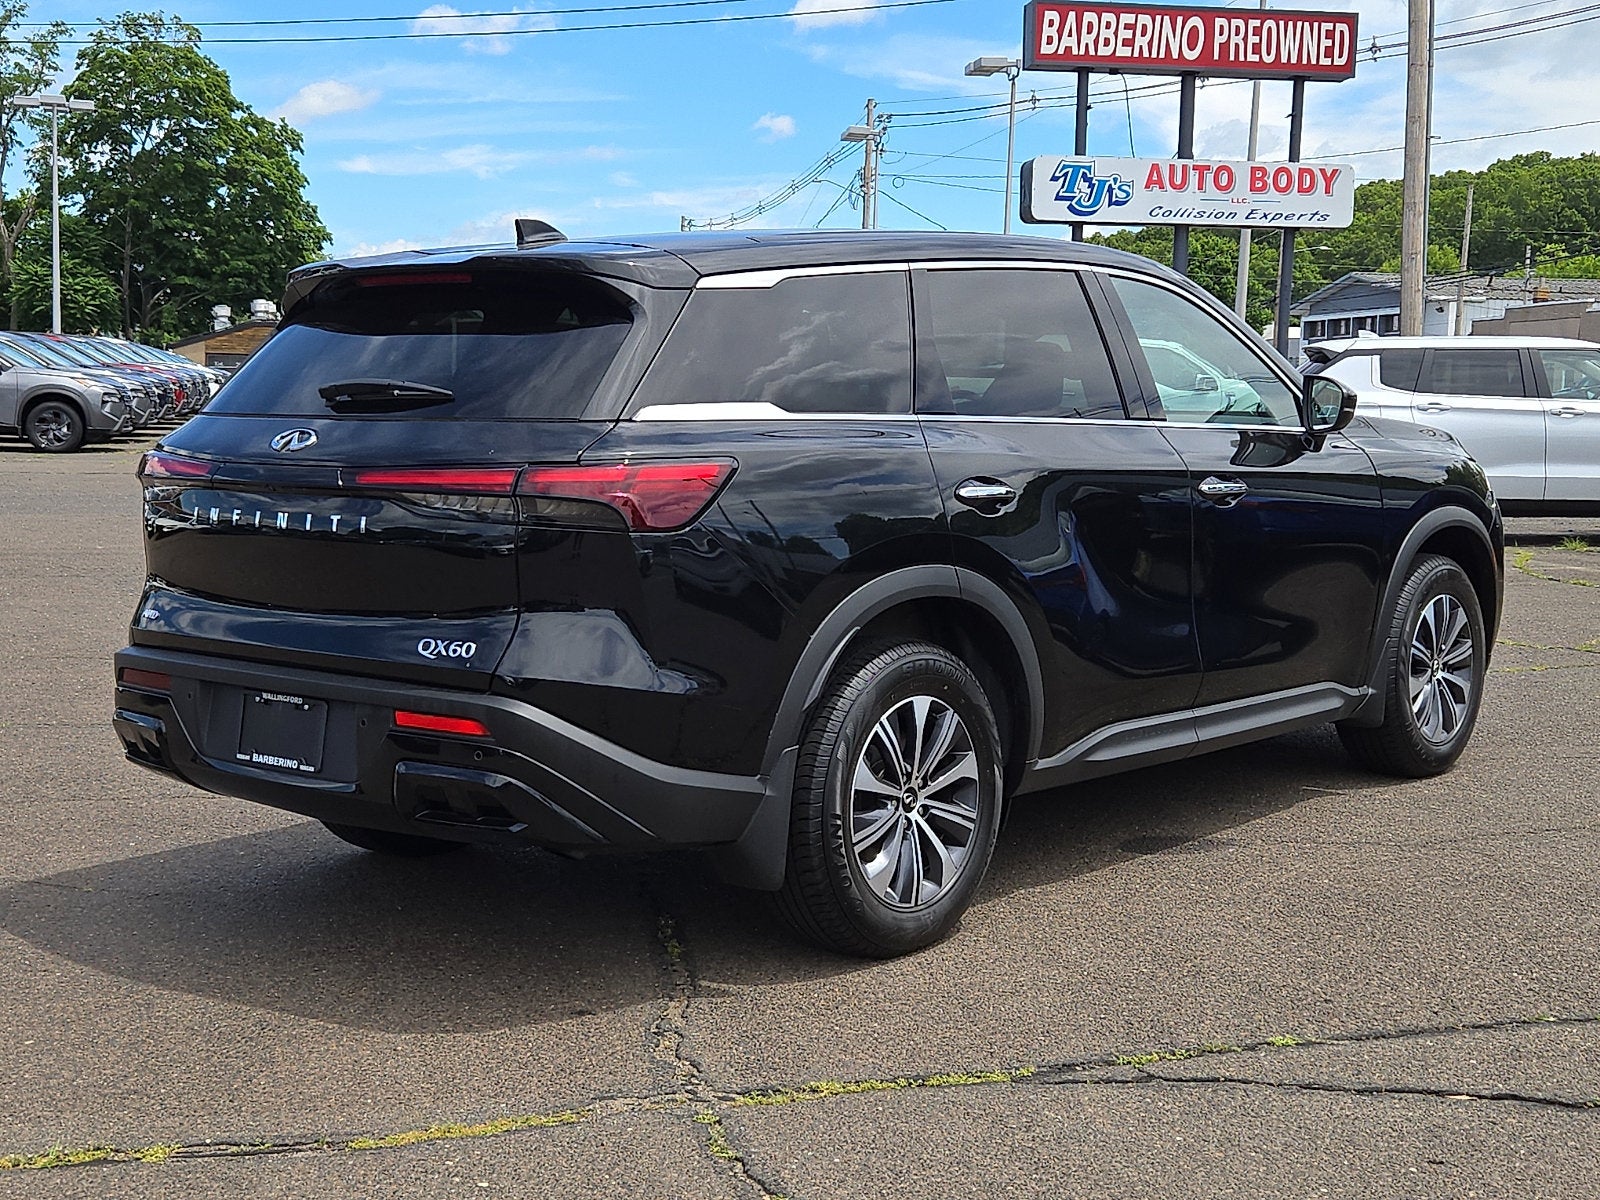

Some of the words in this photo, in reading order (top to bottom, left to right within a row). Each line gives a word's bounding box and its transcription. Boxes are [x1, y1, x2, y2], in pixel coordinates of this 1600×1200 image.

[1040, 10, 1205, 61] BARBERINO
[1213, 17, 1350, 66] PREOWNED
[1049, 159, 1134, 217] TJ's
[1144, 163, 1235, 192] AUTO
[1249, 166, 1341, 196] BODY
[1148, 205, 1238, 220] Collision
[1245, 208, 1331, 223] Experts
[193, 506, 367, 534] INFINITI
[417, 638, 477, 660] QX60
[262, 692, 303, 704] WALLINGFORD
[252, 753, 298, 769] BARBERINO
